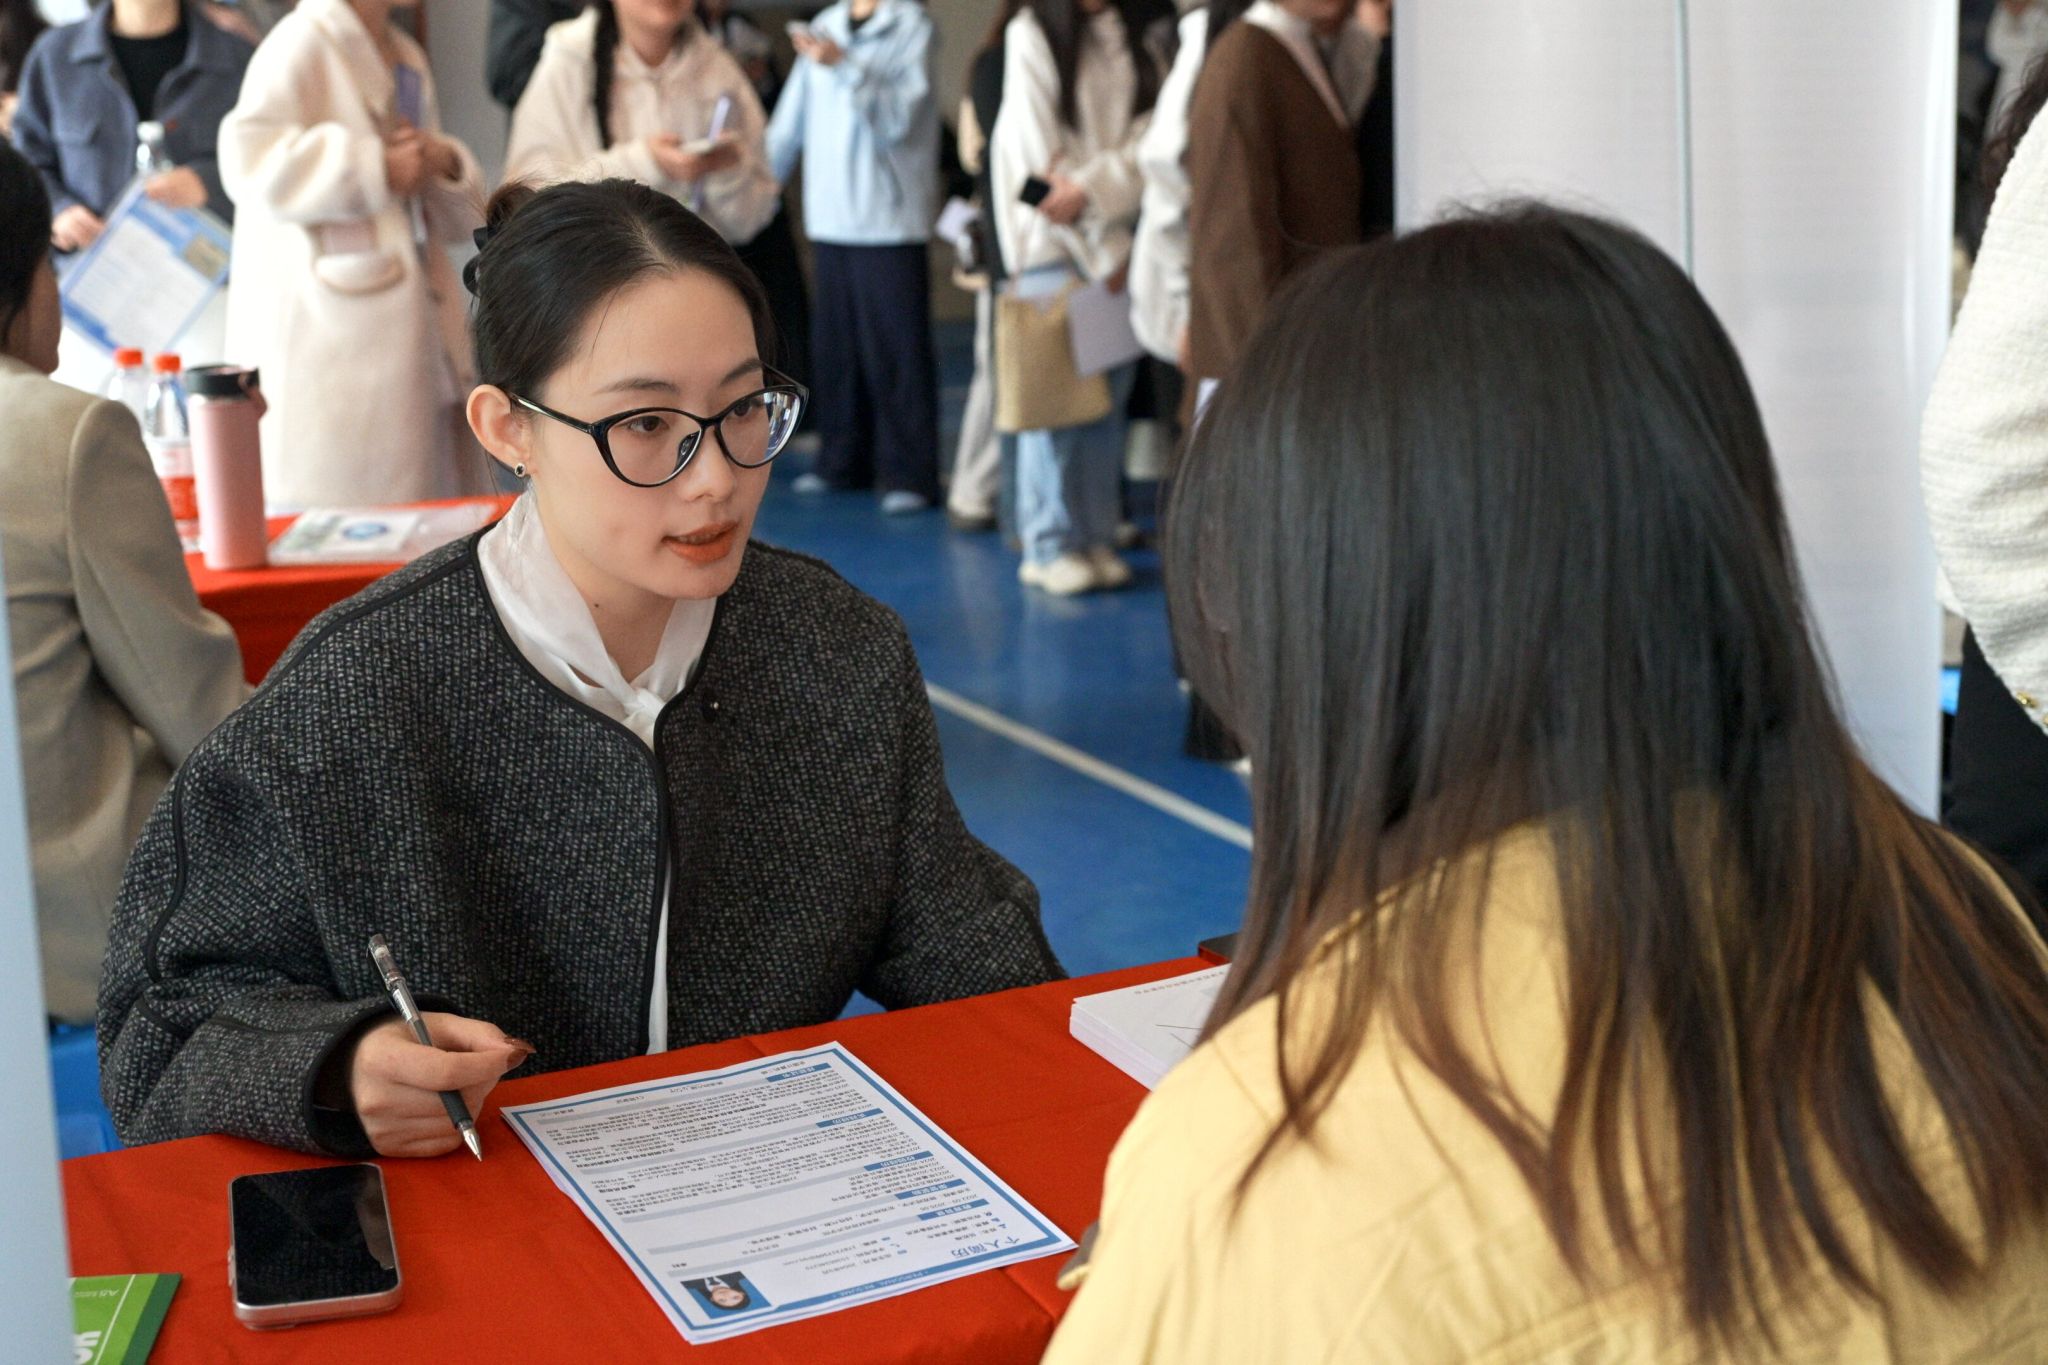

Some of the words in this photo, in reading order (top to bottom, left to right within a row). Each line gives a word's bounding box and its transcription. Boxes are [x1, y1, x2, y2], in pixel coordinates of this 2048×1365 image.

[935, 1203, 972, 1215] 教育背景
[948, 1234, 1021, 1257] 个人简历
